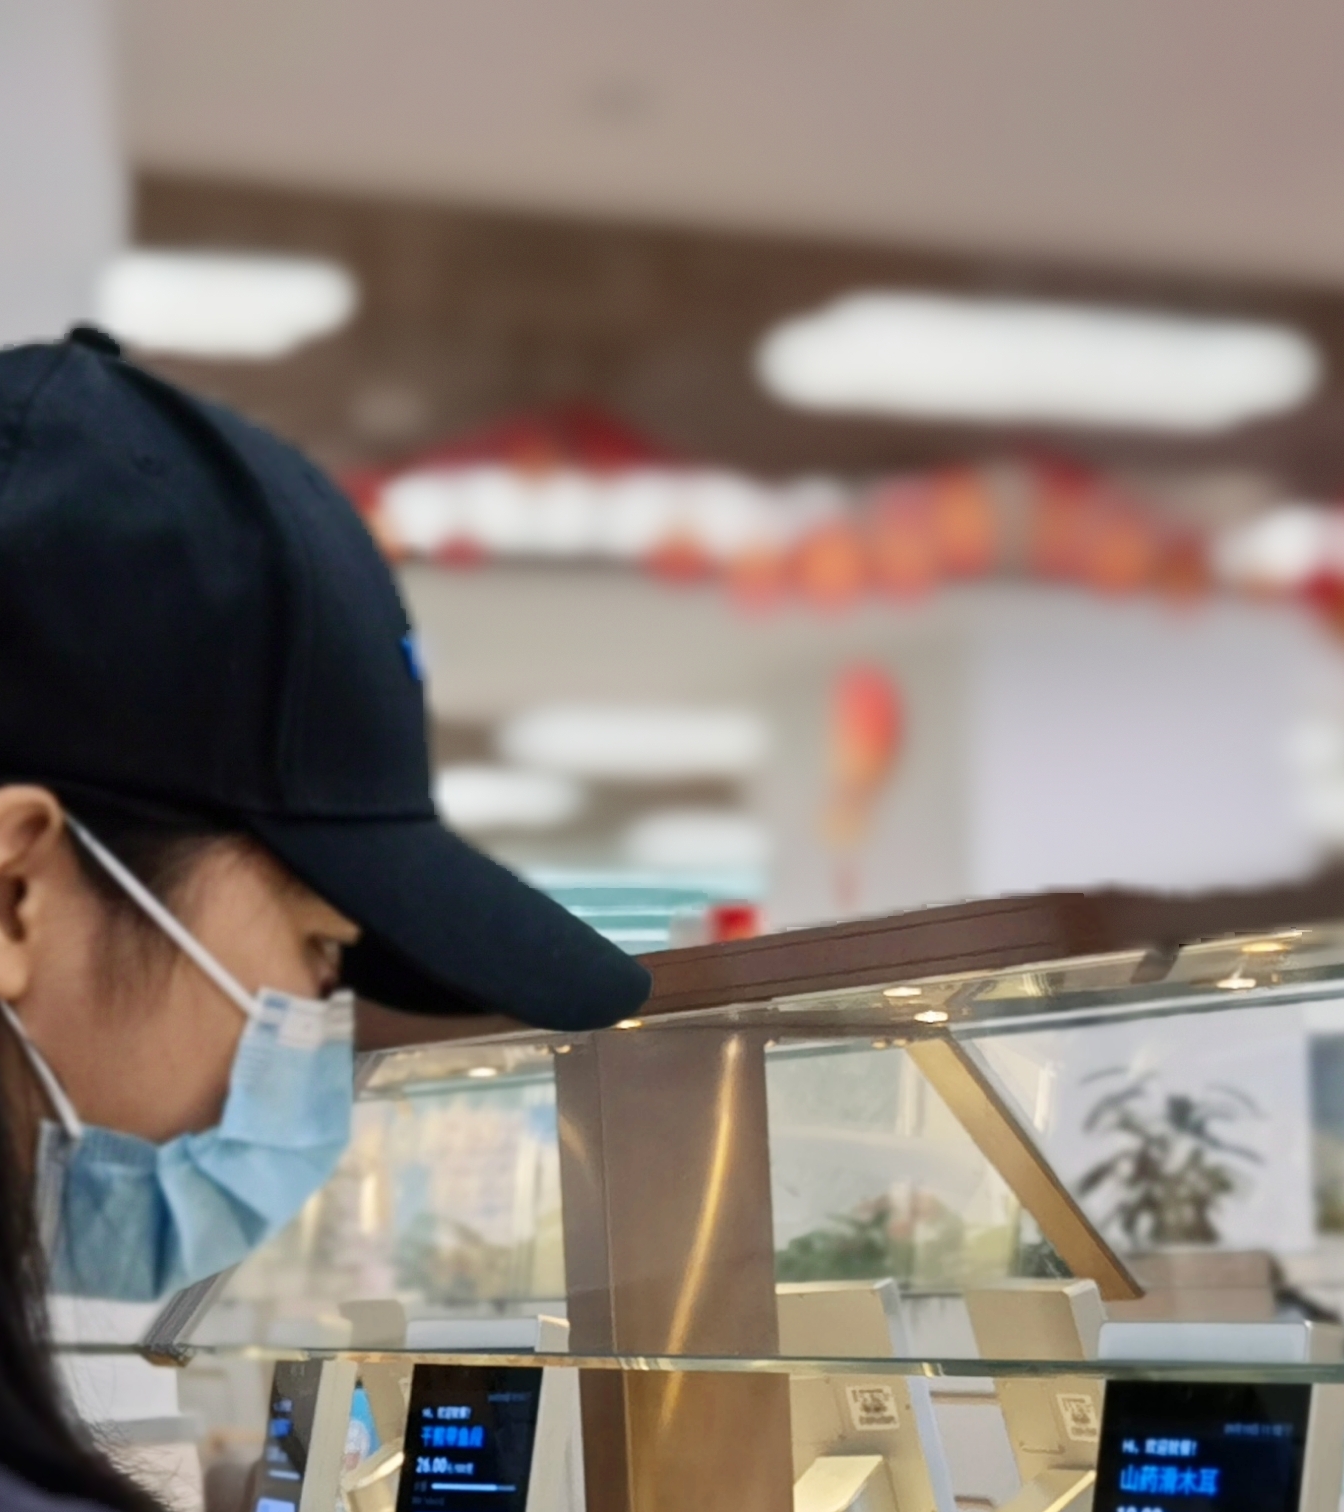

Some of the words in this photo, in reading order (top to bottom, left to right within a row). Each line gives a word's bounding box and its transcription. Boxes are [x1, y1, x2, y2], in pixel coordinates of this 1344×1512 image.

[1119, 1463, 1220, 1497] 山药滑木耳
